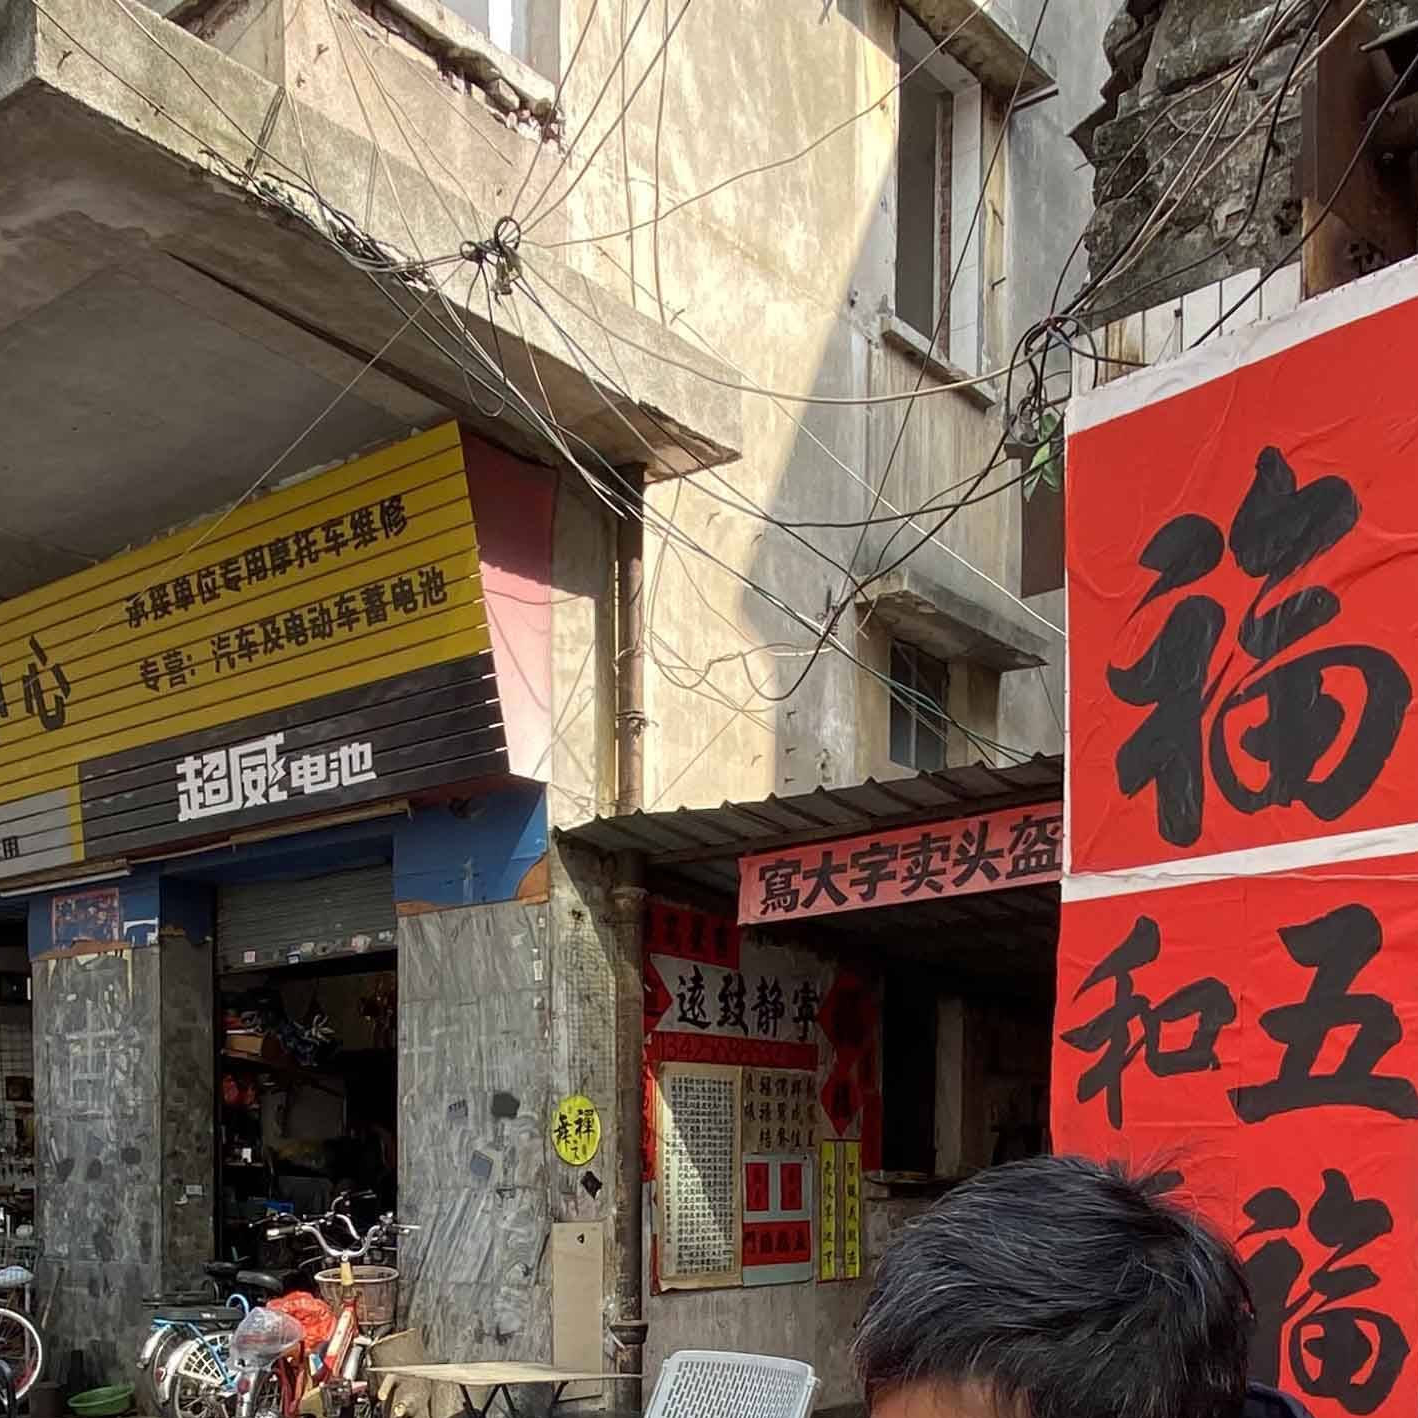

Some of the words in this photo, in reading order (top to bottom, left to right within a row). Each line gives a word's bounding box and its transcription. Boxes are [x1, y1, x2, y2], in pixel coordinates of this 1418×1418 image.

[1108, 446, 1411, 848] 福
[176, 732, 376, 822] 超威电池
